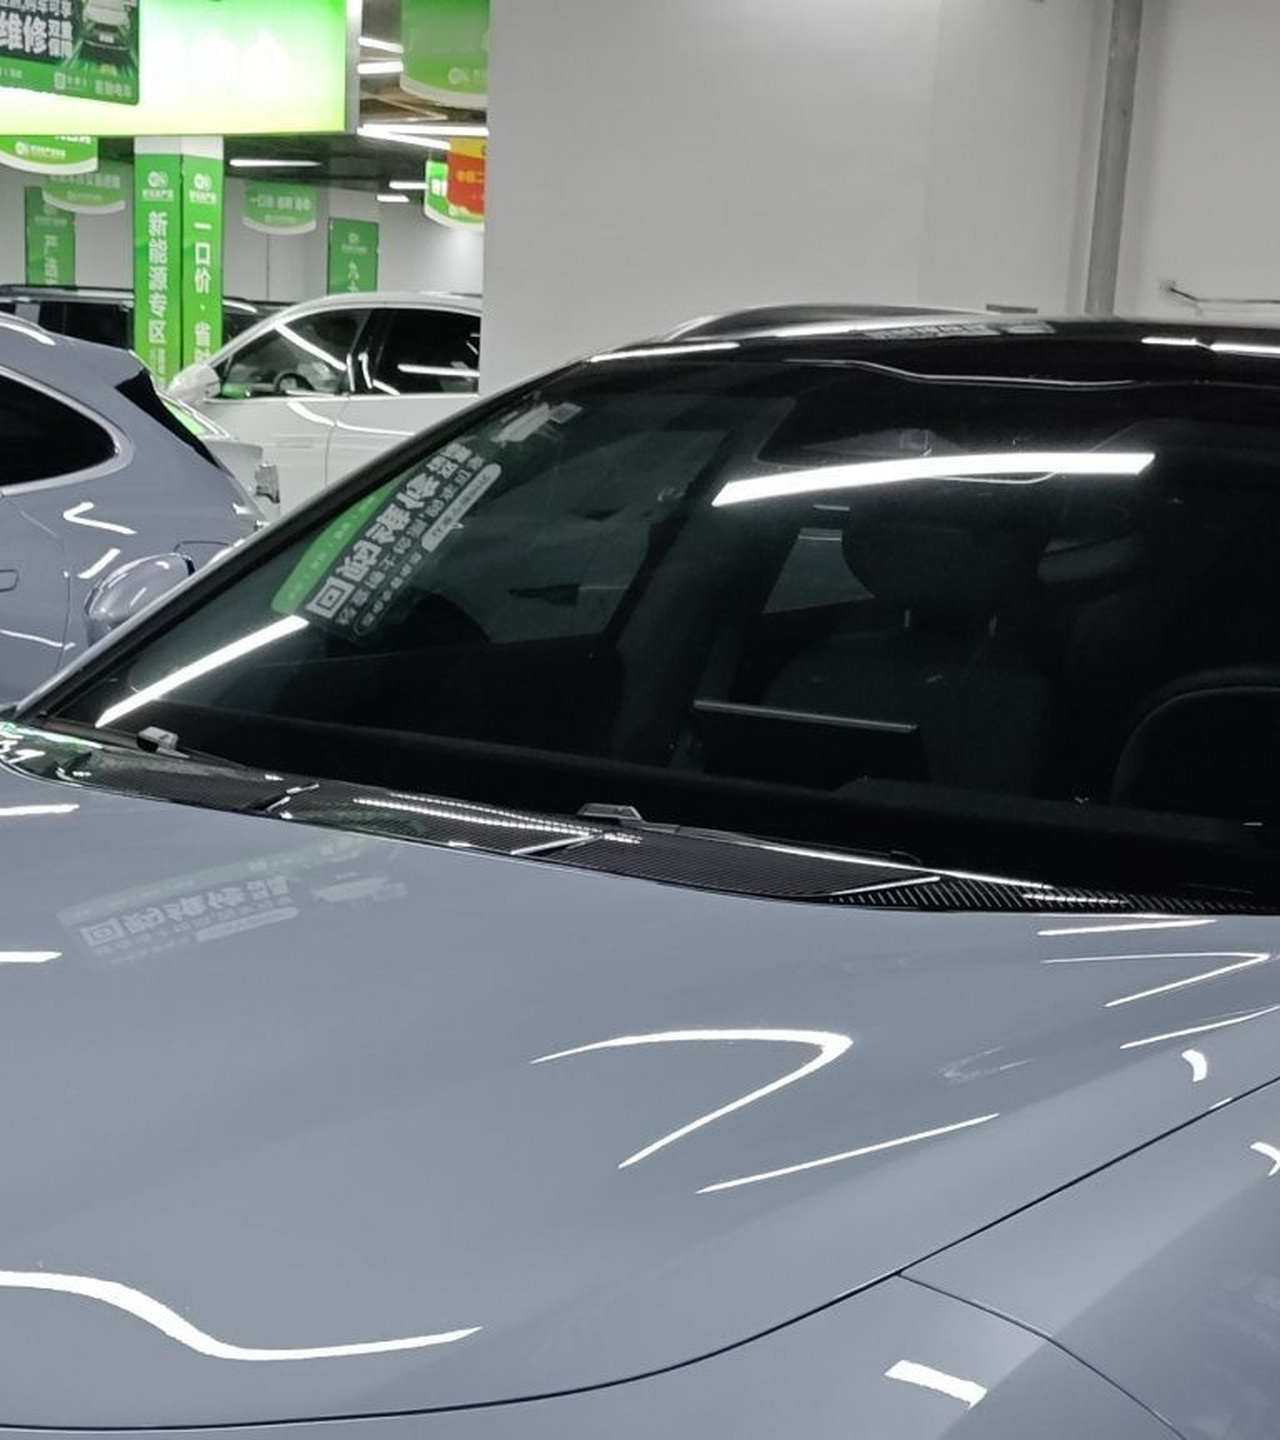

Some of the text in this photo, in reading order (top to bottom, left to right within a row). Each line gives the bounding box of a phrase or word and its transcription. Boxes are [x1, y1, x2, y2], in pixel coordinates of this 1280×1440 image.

[148, 211, 168, 344] 新能源专区
